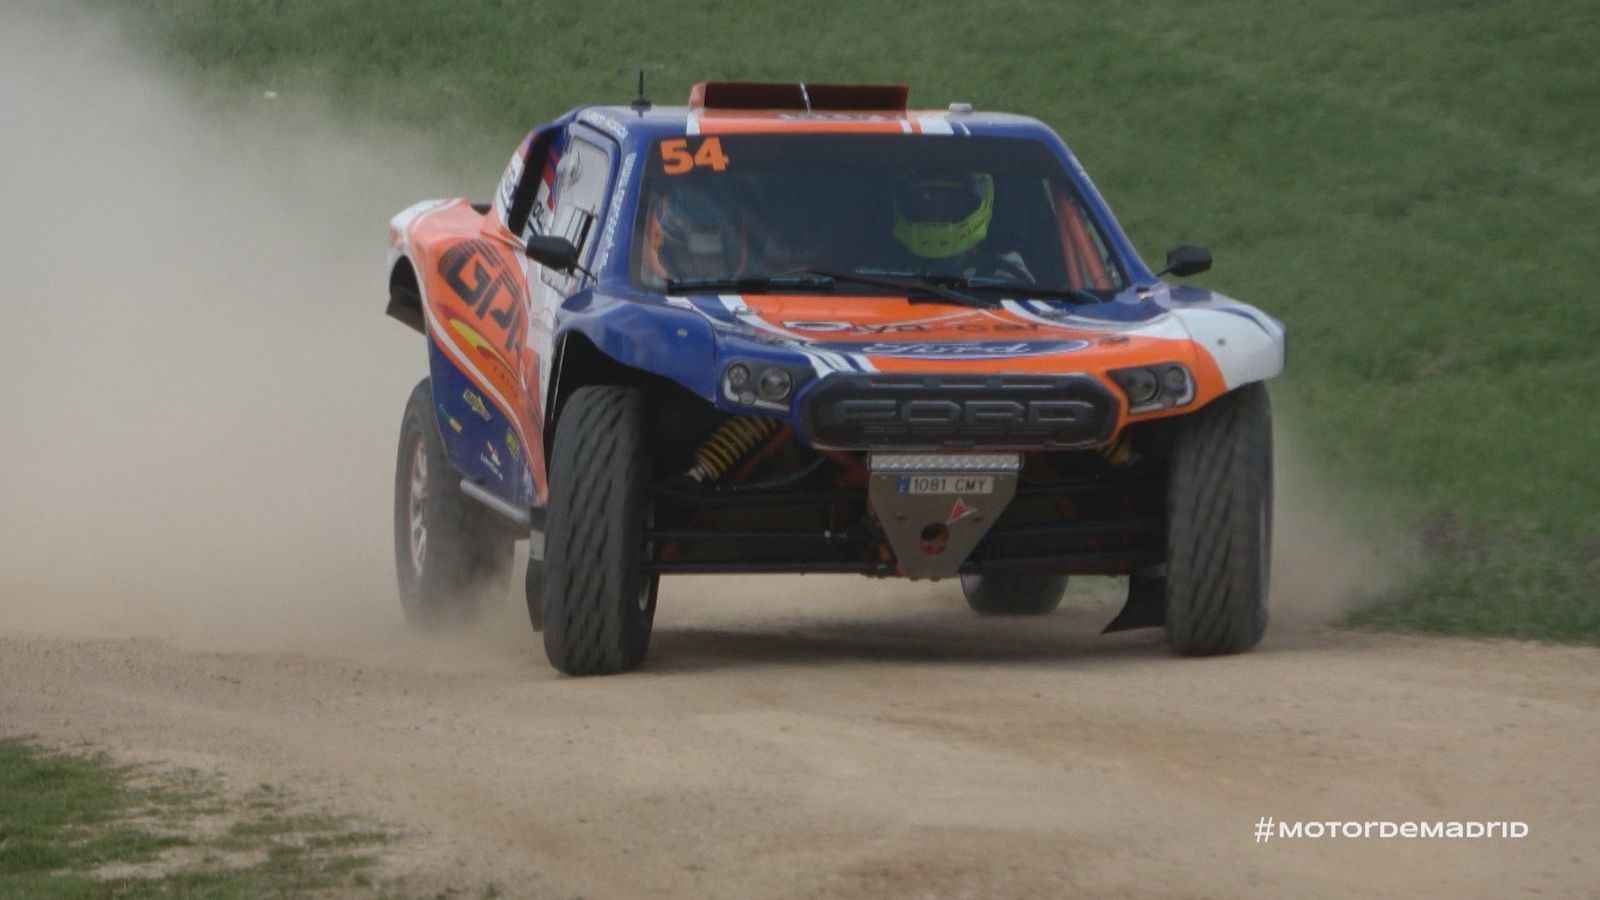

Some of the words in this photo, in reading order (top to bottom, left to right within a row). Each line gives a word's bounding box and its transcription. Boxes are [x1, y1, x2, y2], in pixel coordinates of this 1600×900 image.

[660, 136, 729, 175] 54
[862, 342, 1032, 353] Ford
[832, 399, 1095, 427] FORD
[913, 477, 946, 492] 1081
[954, 477, 986, 492] CMY
